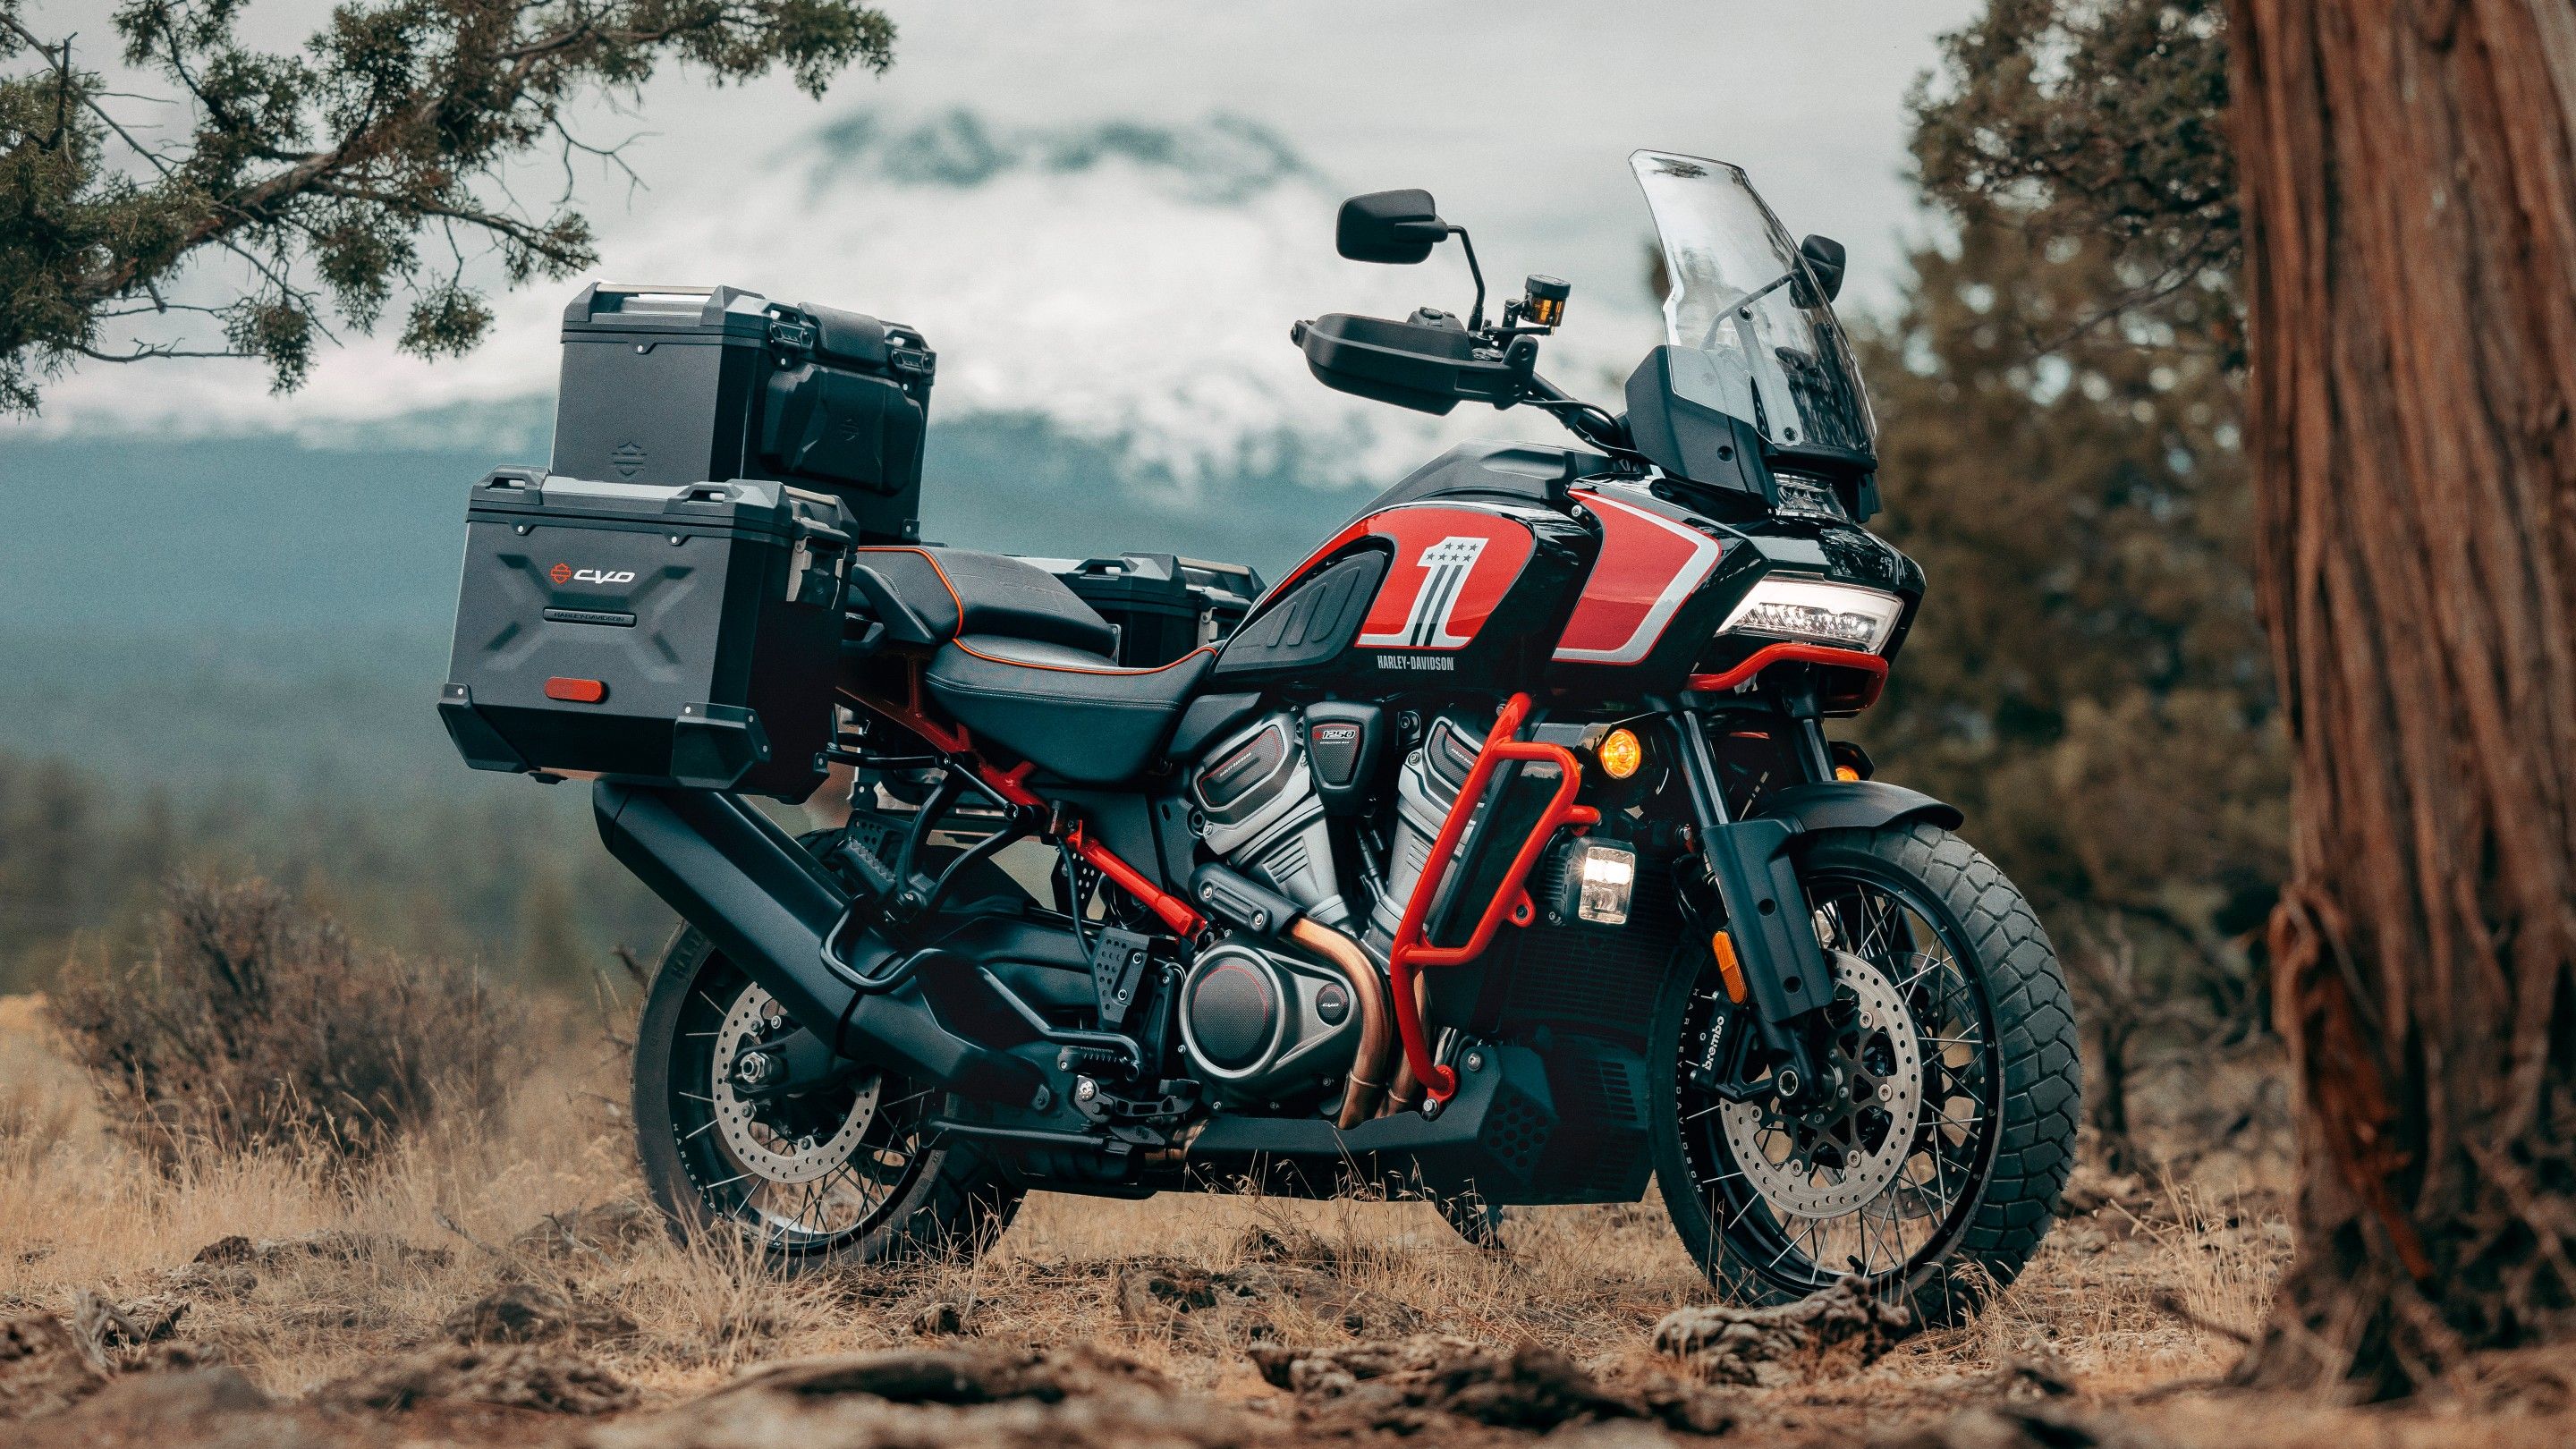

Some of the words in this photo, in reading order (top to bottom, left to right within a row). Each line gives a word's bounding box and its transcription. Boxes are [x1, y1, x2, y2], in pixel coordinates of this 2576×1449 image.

[573, 568, 636, 584] CVO
[1356, 536, 1489, 648] 1
[554, 612, 624, 623] HARLEY-DAVIDSON
[1377, 655, 1454, 671] HARLEY-DAVIDSON
[1323, 730, 1356, 740] 1250
[1701, 1015, 1724, 1072] brembo
[1675, 988, 1703, 1193] HARLEY-DAVIDSON
